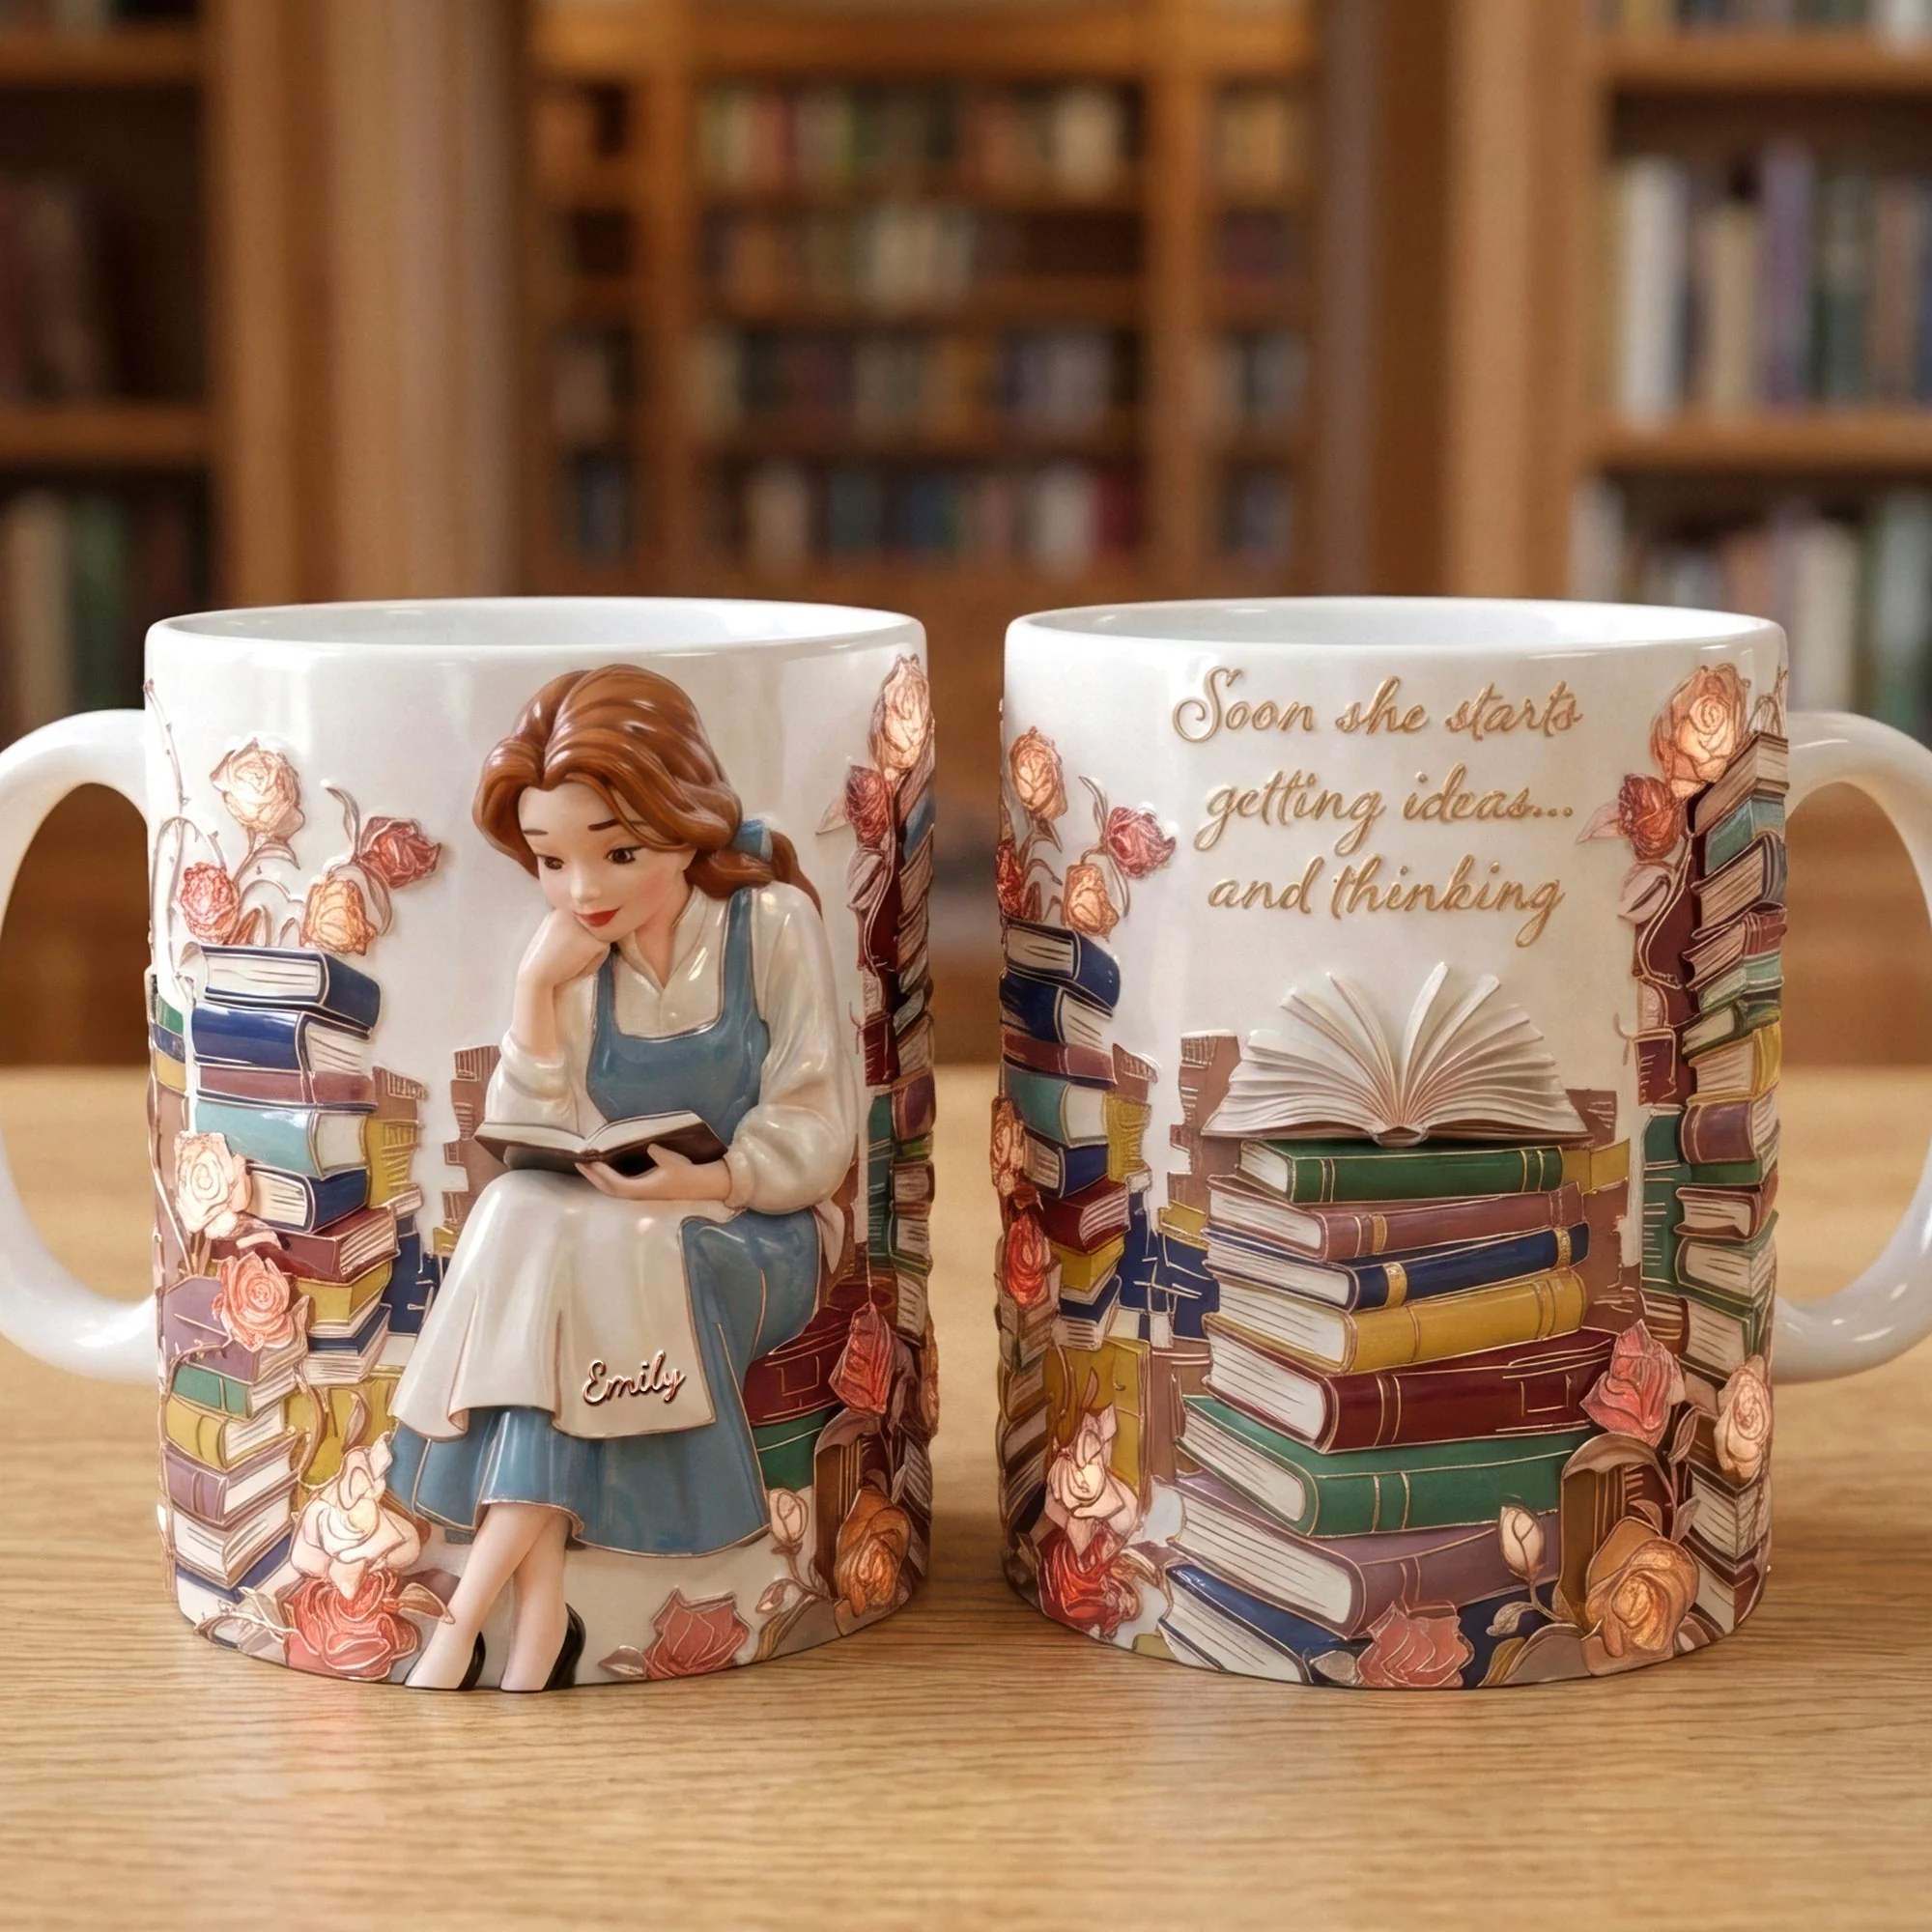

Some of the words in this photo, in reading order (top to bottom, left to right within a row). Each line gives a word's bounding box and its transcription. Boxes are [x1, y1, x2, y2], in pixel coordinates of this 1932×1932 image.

[1172, 666, 1315, 743] Soon
[1335, 676, 1431, 736] she
[1444, 680, 1583, 742] starts
[1193, 769, 1387, 857] getting
[1403, 763, 1575, 824] ideas...
[1208, 855, 1327, 915] and
[1329, 853, 1567, 948] thinking
[582, 1350, 687, 1406] Emily
